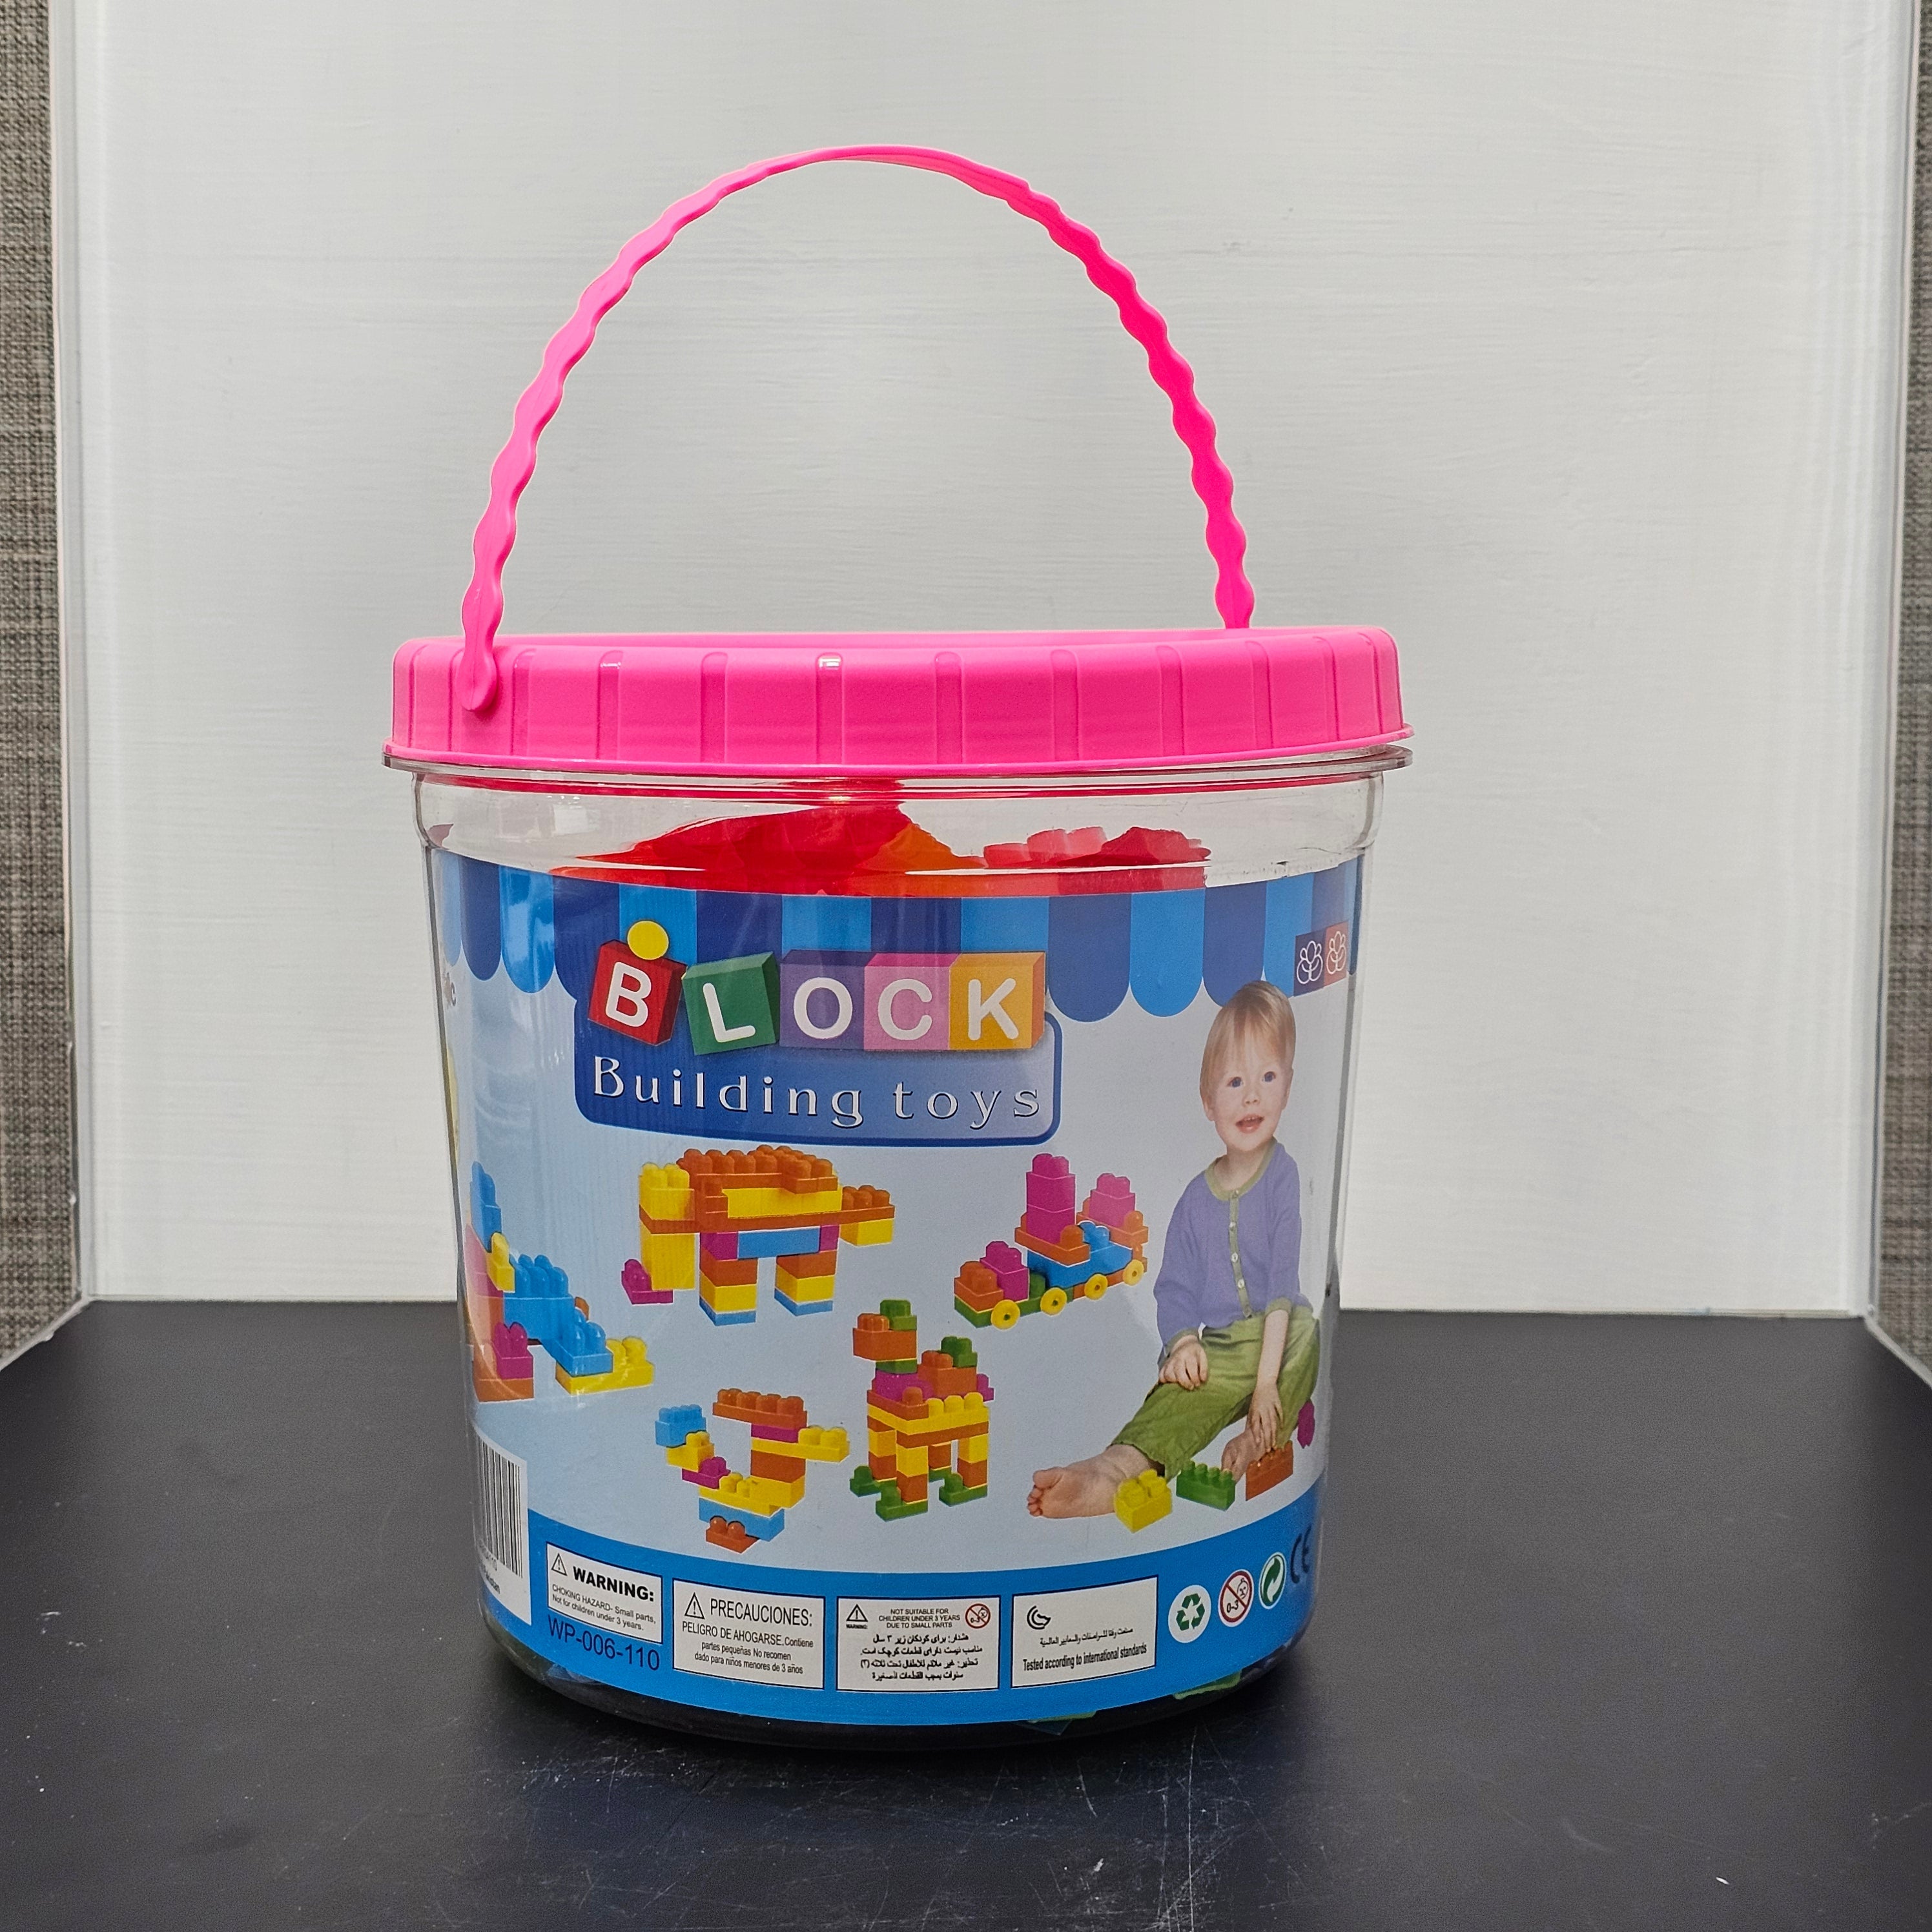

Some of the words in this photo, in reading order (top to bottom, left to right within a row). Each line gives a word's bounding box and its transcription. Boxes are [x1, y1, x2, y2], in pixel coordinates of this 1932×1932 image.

[605, 961, 1019, 1043] BLOCK
[593, 1056, 864, 1128] Building
[893, 1082, 1040, 1129] toys
[573, 1566, 653, 1602] WARNING:
[553, 1584, 581, 1601] CHOKING
[615, 1606, 633, 1618] Small
[636, 1612, 656, 1624] parts,
[553, 1594, 562, 1604] Not
[572, 1603, 594, 1617] children
[597, 1612, 615, 1623] under
[622, 1619, 644, 1630] years.
[711, 1598, 812, 1627] PRECAUCIONES:
[549, 1614, 659, 1670] WP-006-110
[683, 1621, 717, 1637] PELIGRO
[721, 1627, 731, 1639] DE
[695, 1652, 709, 1662] dado
[711, 1656, 724, 1665] para
[744, 1661, 770, 1670] menores
[772, 1663, 779, 1672] de
[782, 1663, 786, 1672] 3
[788, 1664, 803, 1674] años
[702, 1641, 720, 1652] partes
[721, 1646, 751, 1656] pequeñas
[754, 1648, 762, 1657] No
[764, 1652, 791, 1661] recomen
[1023, 1657, 1043, 1671] Tested
[1045, 1655, 1074, 1669] according
[1076, 1654, 1082, 1665] to
[1084, 1647, 1119, 1664] international
[1120, 1641, 1147, 1658] standards
